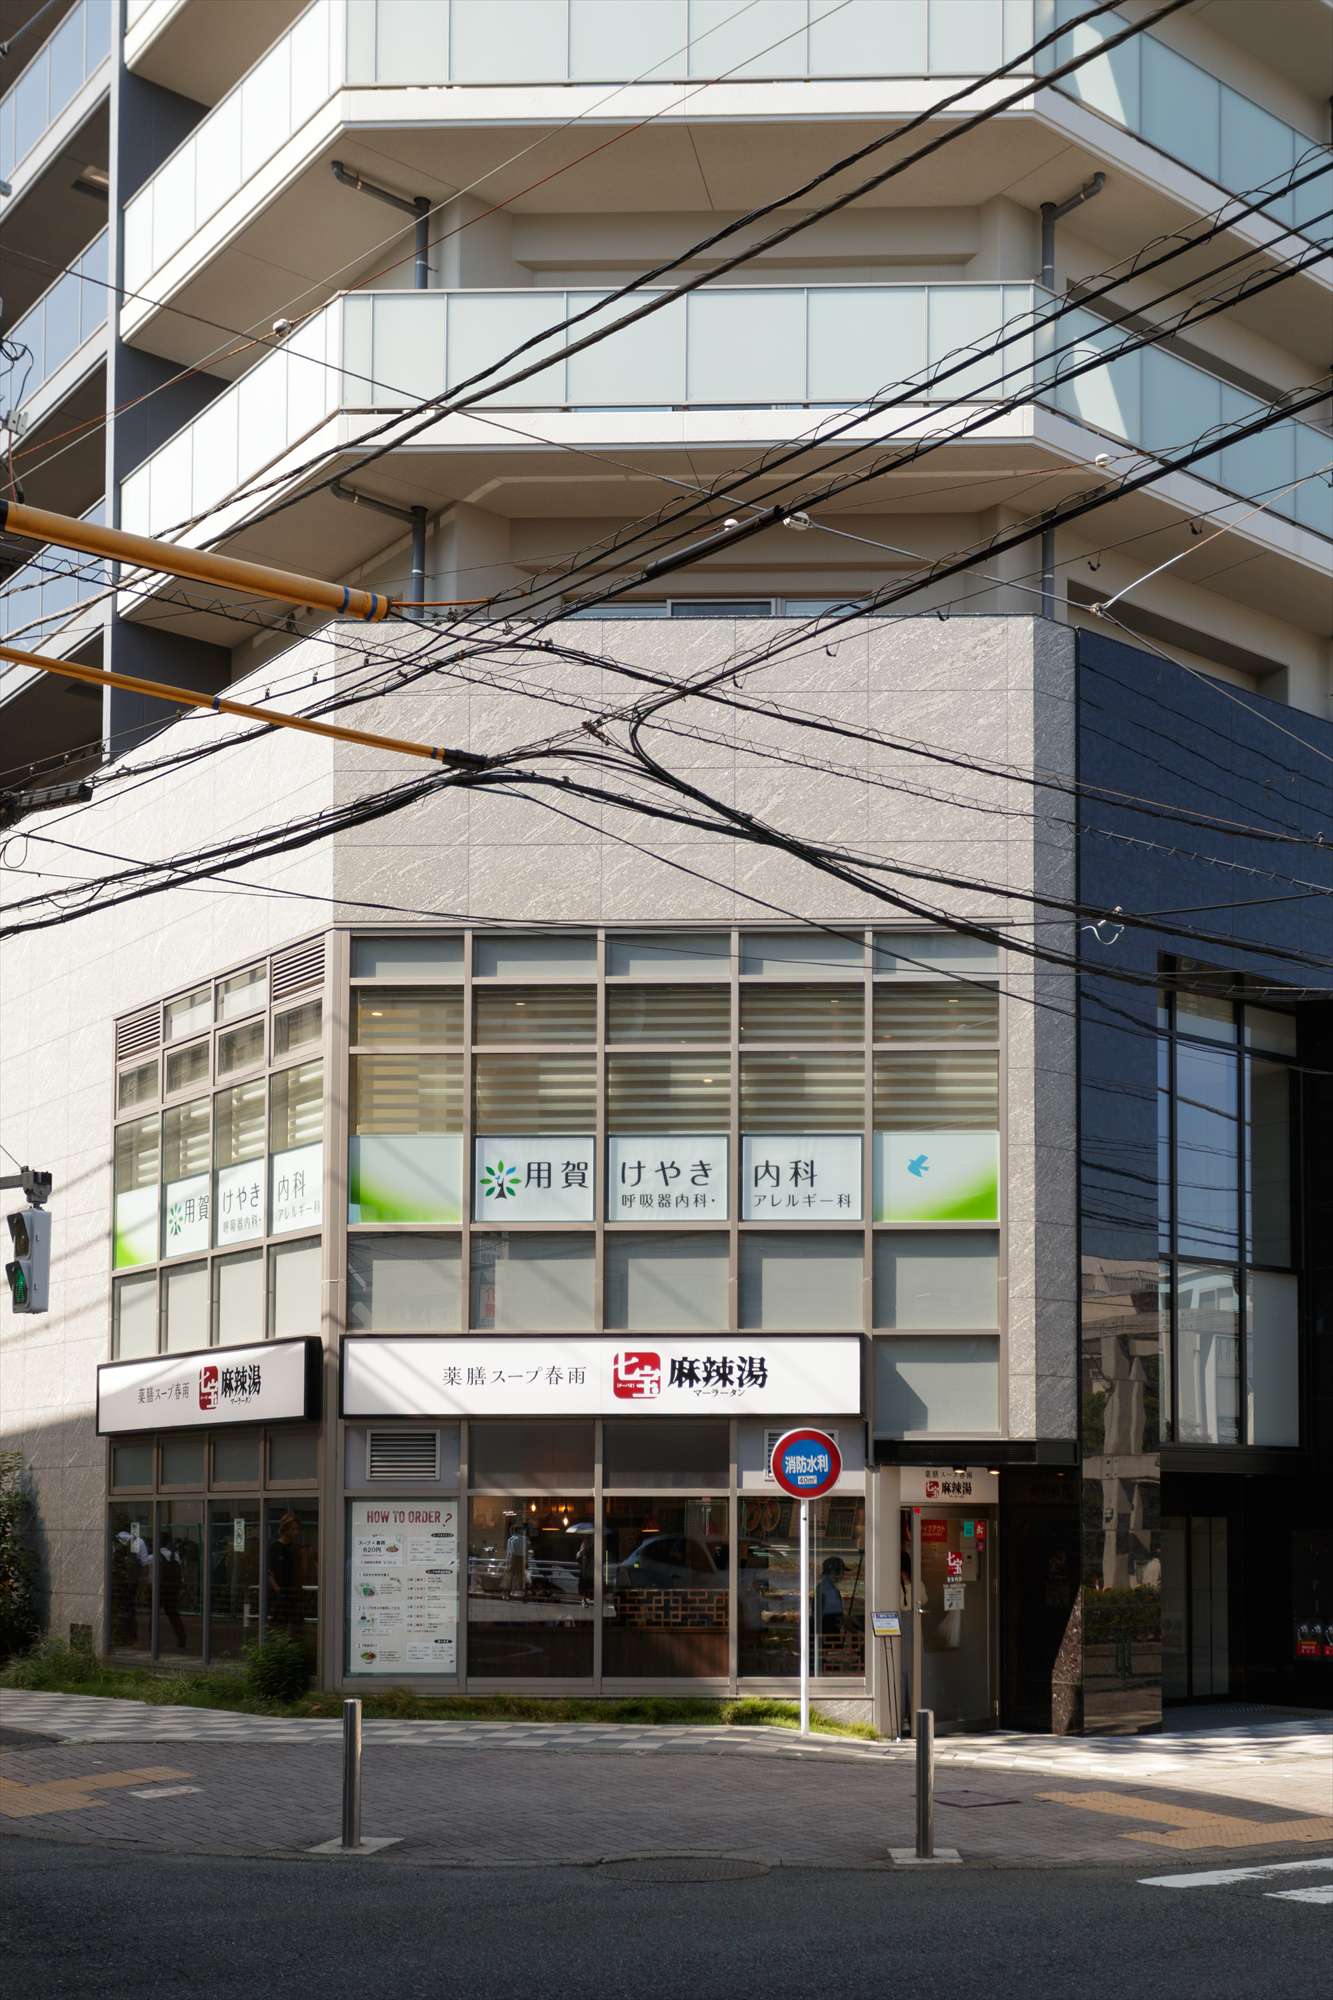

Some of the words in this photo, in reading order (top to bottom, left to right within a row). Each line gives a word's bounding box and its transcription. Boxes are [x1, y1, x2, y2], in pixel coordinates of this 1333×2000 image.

[525, 1160, 589, 1189] 用賀
[621, 1160, 713, 1187] けやき
[754, 1160, 818, 1188] 内科
[184, 1195, 209, 1225] 用賀
[223, 1183, 261, 1214] けやき
[277, 1169, 307, 1203] 内科
[753, 1193, 851, 1209] アレルギー科
[221, 1364, 262, 1399] 麻辣湯
[442, 1366, 587, 1386] 薬膳スープ春雨
[668, 1356, 768, 1389] 麻辣湯
[693, 1389, 745, 1397] マーラータン
[785, 1454, 829, 1474] 消防水利
[367, 1510, 390, 1523] HOW
[392, 1510, 405, 1523] TO
[408, 1510, 441, 1523] ORDER
